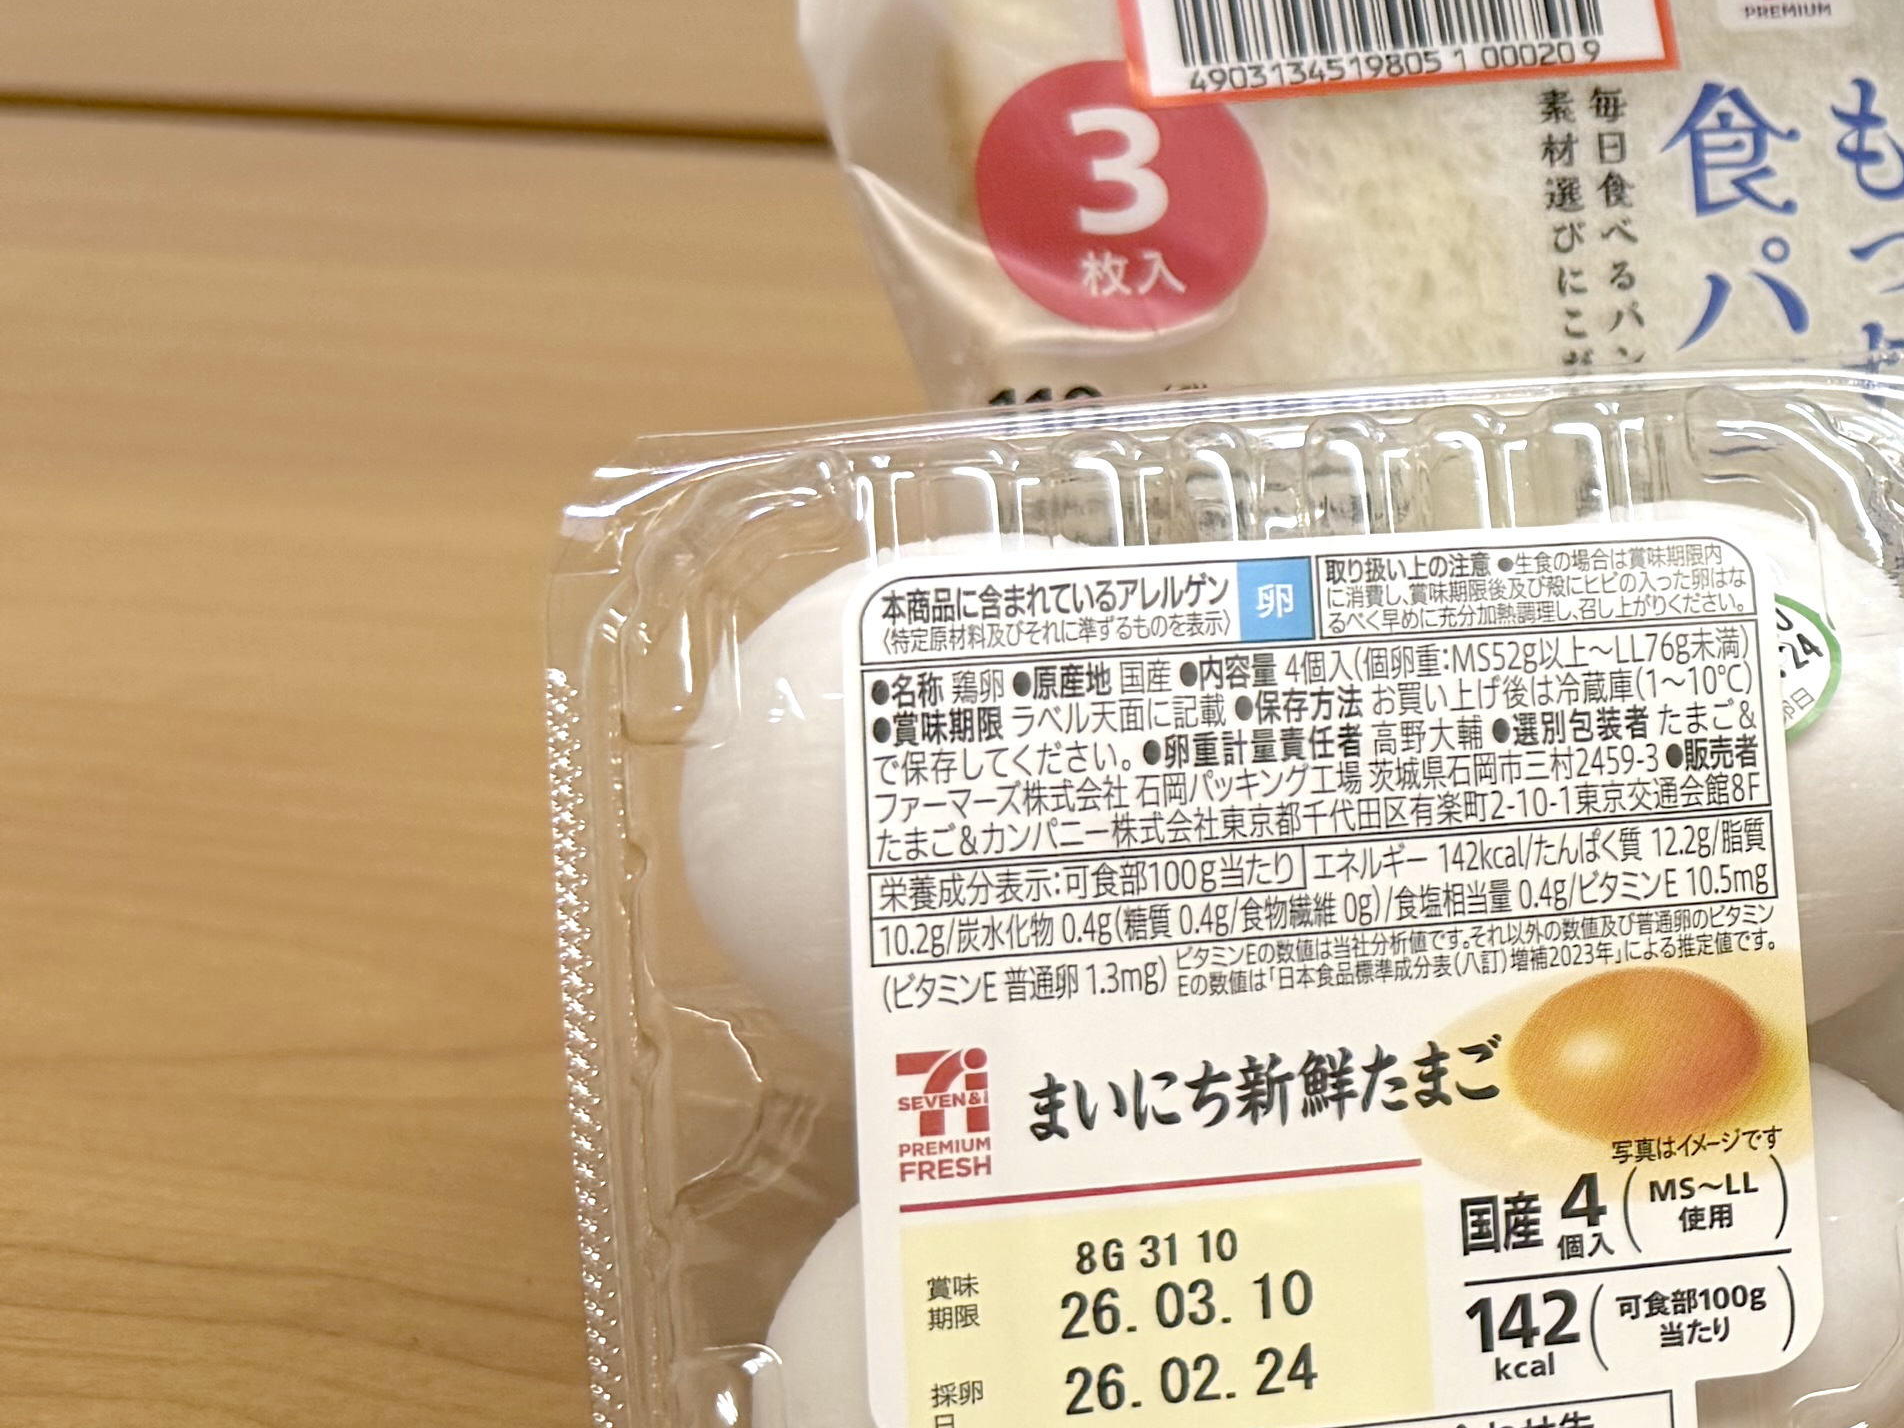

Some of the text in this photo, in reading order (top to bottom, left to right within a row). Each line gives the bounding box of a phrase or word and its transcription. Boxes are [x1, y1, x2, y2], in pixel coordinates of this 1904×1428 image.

[1744, 2, 1832, 20] PREMIUM
[1189, 46, 1443, 92] 4903134519805
[1069, 107, 1170, 235] 3
[1081, 250, 1187, 298] 枚入
[1326, 543, 1722, 583] 取り扱い上の注意 生食の場合は賞味期限内
[882, 576, 1294, 622] 本商品に含まれているアレルゲン 卵
[892, 653, 1277, 708] 名称 鶏卵 原産地 国産 内容量
[892, 683, 1363, 748] 賞味期限 ラベル天面に記載 保存方法
[873, 707, 1649, 787] で保存してください。 卵重計量責任者 高野大輔 選別包装者
[875, 737, 1759, 824] ファーマーズ株式会社 石岡パッキング工場 茨城県石岡市三村2459-3 販売者
[1314, 849, 1428, 882] エネルギー
[1439, 826, 1641, 873] 142kcal/たんぱく質
[1652, 817, 1766, 860] 12.2g/脂質
[881, 910, 1054, 959] 10.2g/炭水化物
[1179, 889, 1336, 939] 0.4g/食物繊維
[1519, 869, 1677, 915] 0.4g/ビタミンE
[1687, 862, 1770, 900] 10.5mg
[1005, 955, 1168, 1004] 普通卵 1.3mg)
[1028, 1034, 1502, 1142] まいにち新鮮たまご
[898, 1137, 992, 1158] PREMIUM
[1612, 1125, 1783, 1165] 写真はイメージです
[899, 1155, 992, 1183] FRESH
[1460, 1172, 1607, 1256] 国産 4
[1679, 1203, 1733, 1233] 使用
[1075, 1227, 1238, 1275] 8G 31 10
[1557, 1231, 1615, 1261] 個入
[927, 1274, 979, 1303] 賞味
[1254, 1268, 1314, 1320] 10
[1616, 1283, 1767, 1321] 可食部100g
[928, 1304, 981, 1332] 期限
[1465, 1288, 1581, 1354] 142
[1660, 1318, 1730, 1348] 当たり
[1256, 1341, 1318, 1396] 24
[1495, 1351, 1556, 1382] kcal
[931, 1379, 984, 1409] 採卵
